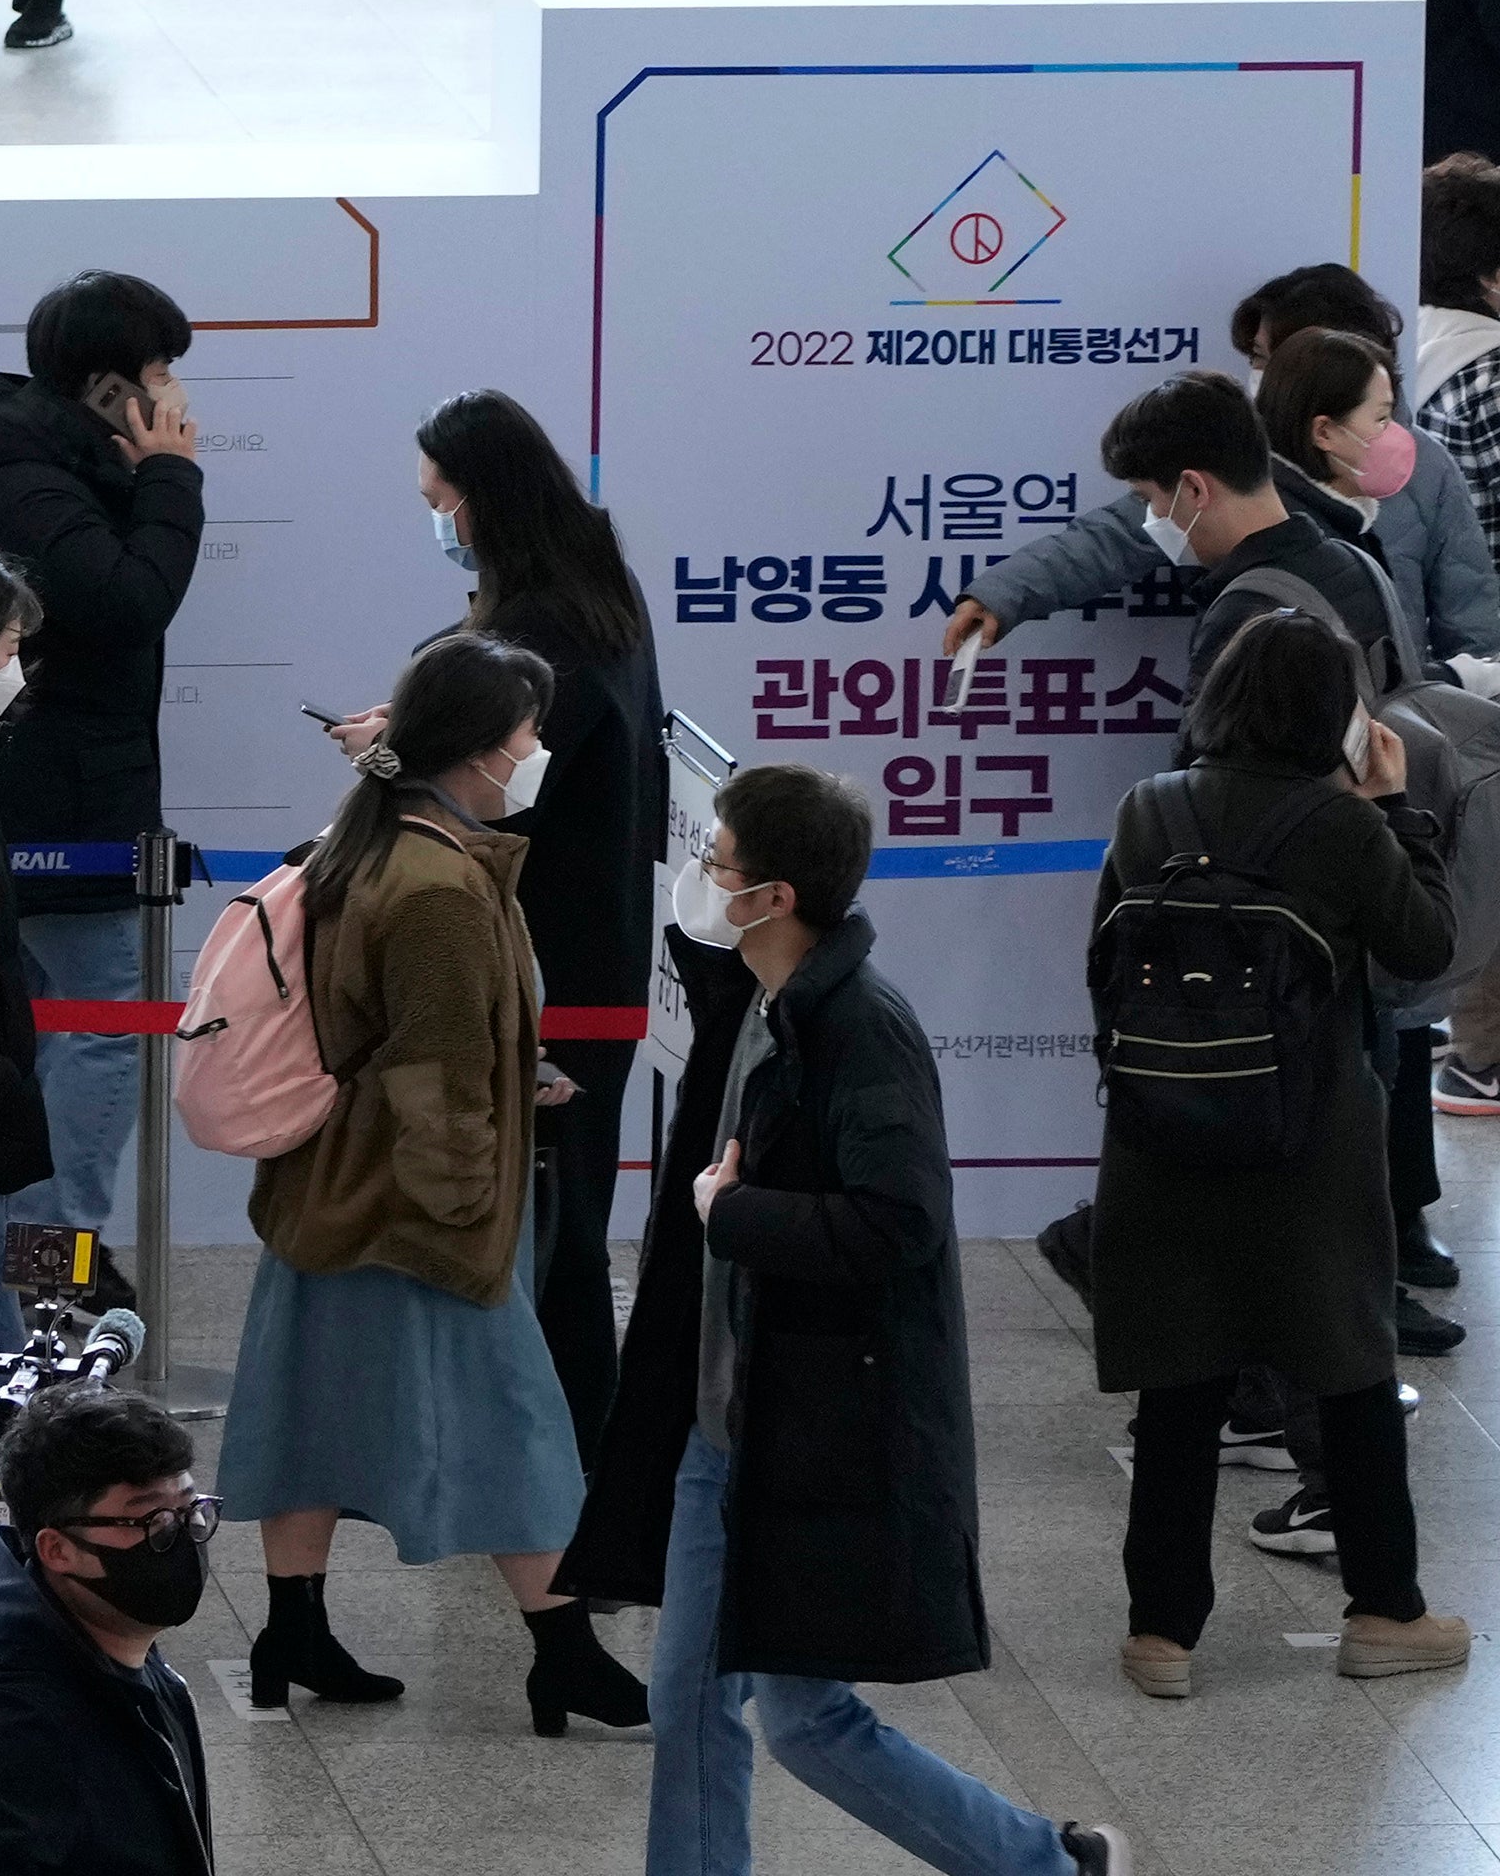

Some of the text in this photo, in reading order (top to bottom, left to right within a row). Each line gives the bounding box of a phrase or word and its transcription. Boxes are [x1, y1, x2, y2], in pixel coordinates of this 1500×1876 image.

[751, 327, 1200, 366] 2022 제20대 대통령선거
[866, 473, 1078, 541] 서울역
[203, 543, 240, 560] 따라
[674, 555, 887, 623] 남영동
[164, 686, 203, 704] 니다.
[882, 755, 1054, 837] 입구
[10, 852, 71, 871] RAIL
[930, 1034, 1097, 1059] 구선거관리위원회
